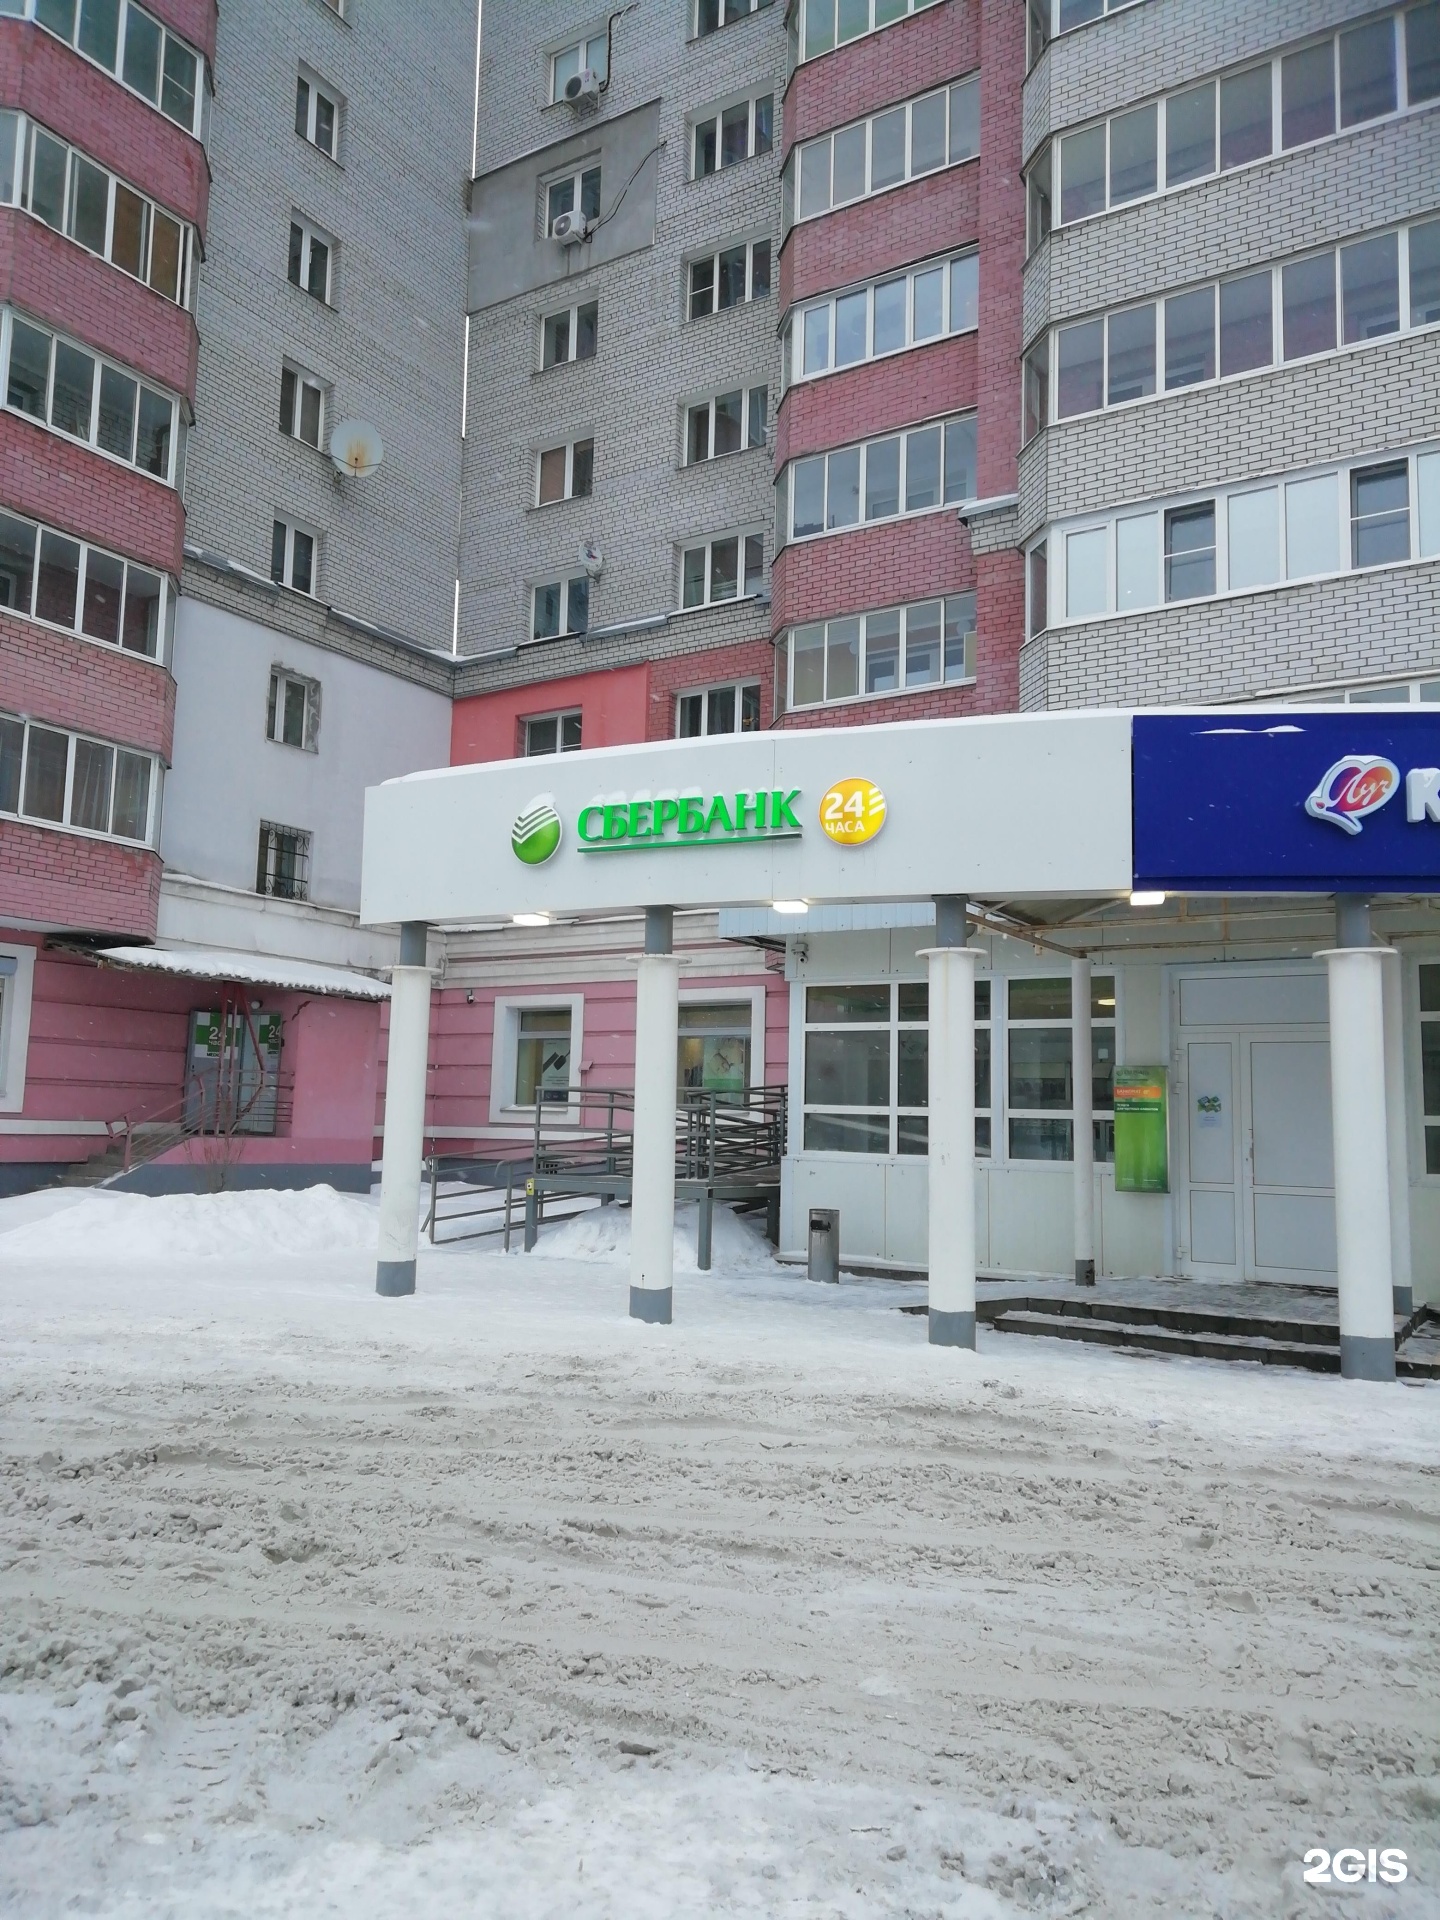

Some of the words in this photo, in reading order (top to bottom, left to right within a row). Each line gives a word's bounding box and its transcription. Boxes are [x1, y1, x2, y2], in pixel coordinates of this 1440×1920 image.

[578, 788, 803, 842] СБЕРБАНК
[825, 791, 864, 818] 24
[826, 819, 864, 834] ЧАСА
